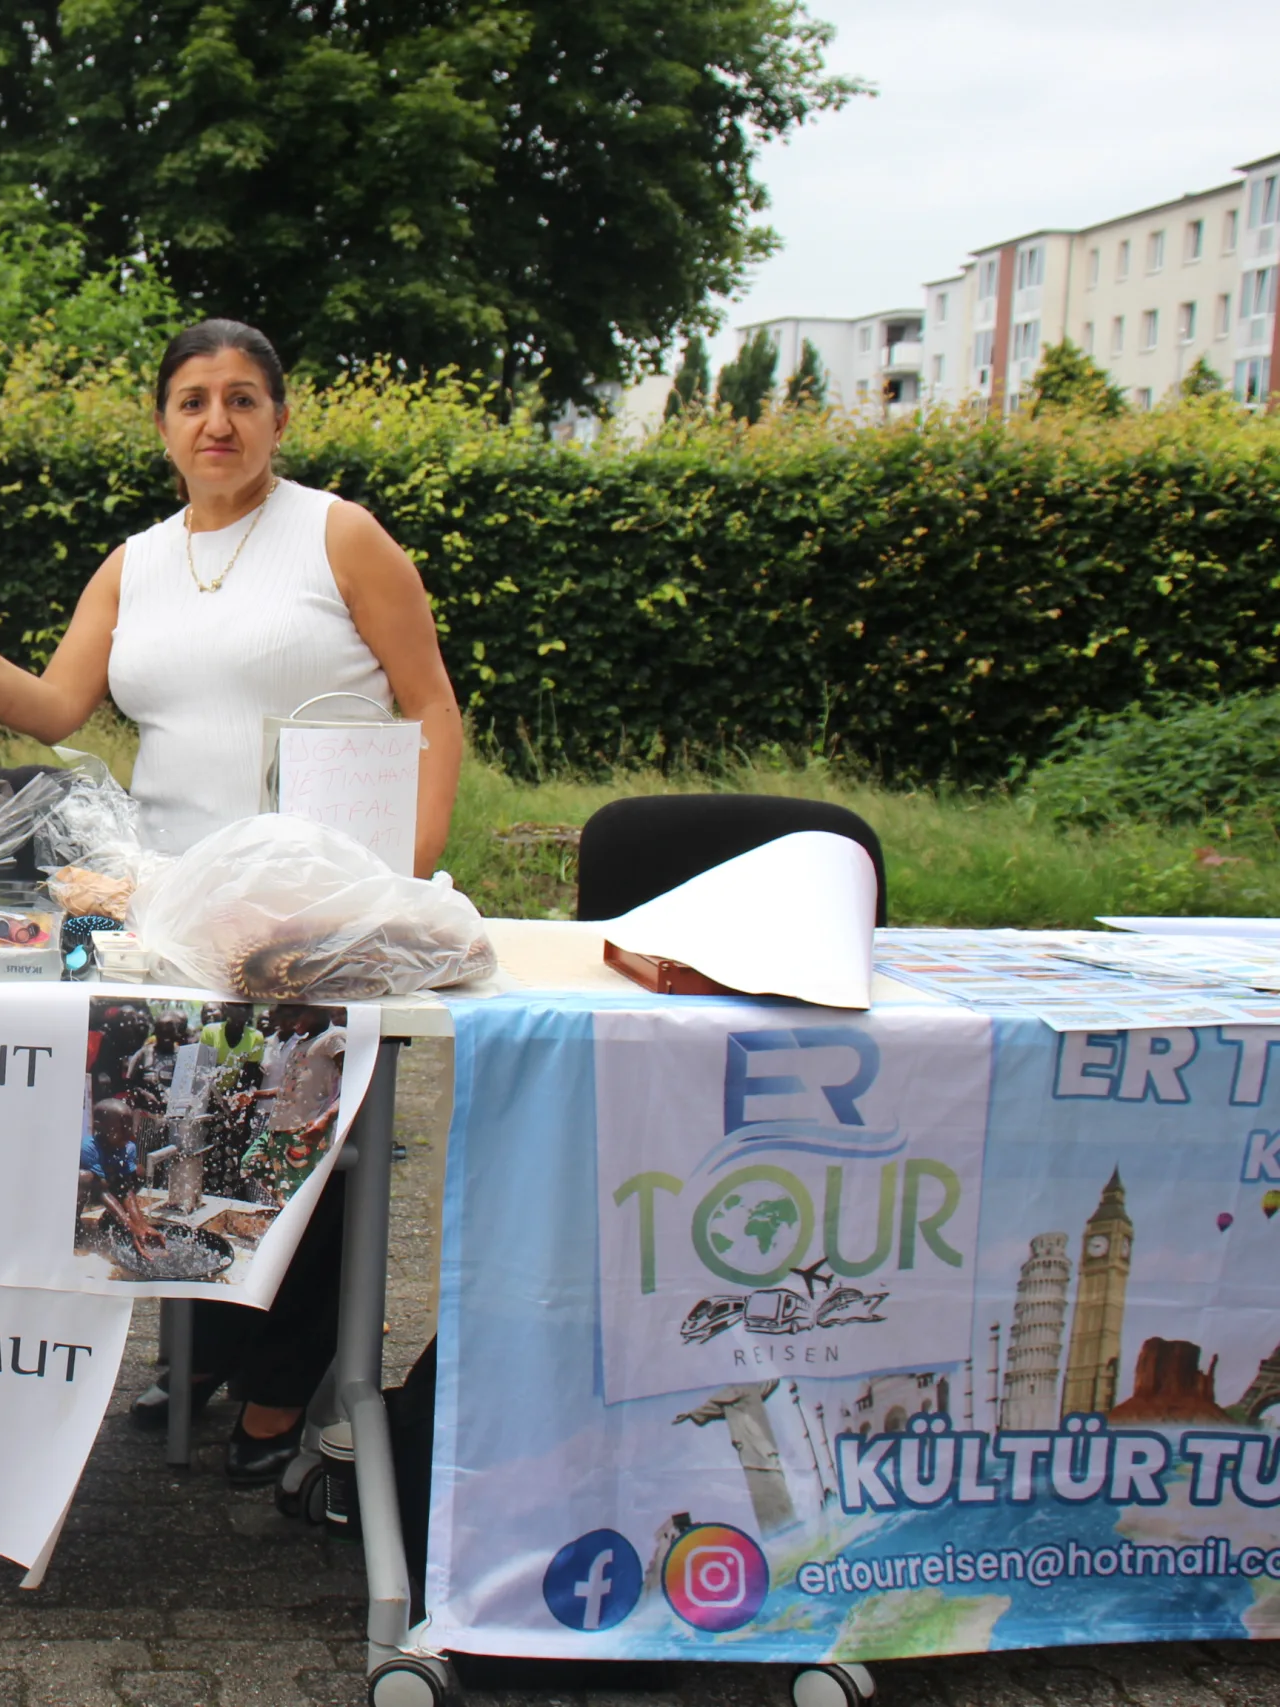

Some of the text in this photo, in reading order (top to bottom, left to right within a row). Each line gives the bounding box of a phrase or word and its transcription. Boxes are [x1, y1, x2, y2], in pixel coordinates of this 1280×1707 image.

[724, 1025, 880, 1136] ER
[1053, 1027, 1200, 1105] ER
[613, 1158, 964, 1295] TOUR
[734, 1344, 840, 1367] REISEN
[836, 1413, 1171, 1513] KÜLTÜR
